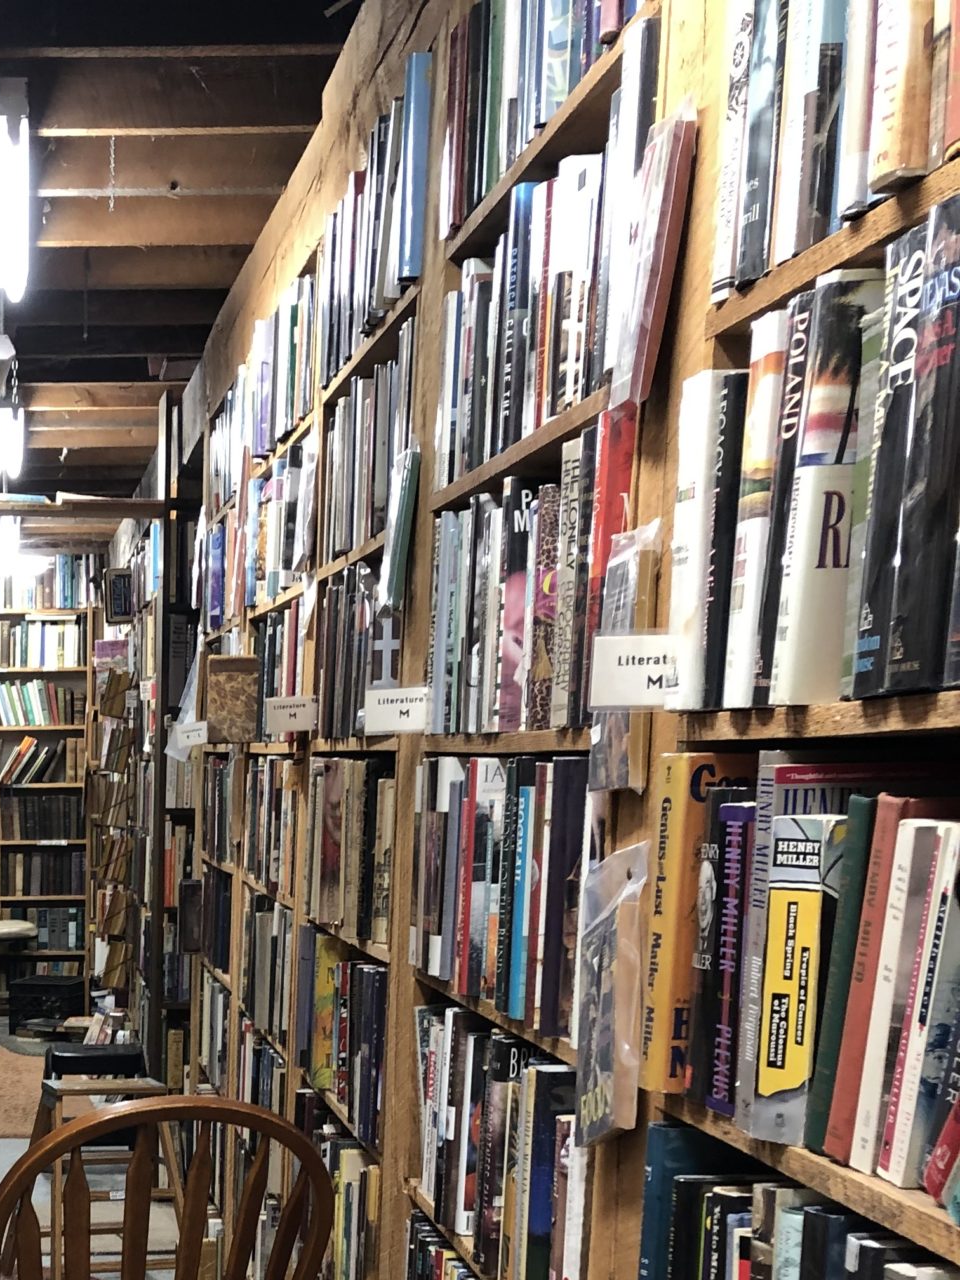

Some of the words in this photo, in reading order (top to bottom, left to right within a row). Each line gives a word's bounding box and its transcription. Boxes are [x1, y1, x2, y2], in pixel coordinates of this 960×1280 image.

[504, 318, 515, 354] CALL
[886, 250, 927, 396] SPACE
[502, 362, 512, 384] ME
[778, 310, 810, 440] POLAND
[712, 386, 729, 478] LEGACY
[565, 496, 578, 571] LONELY
[617, 654, 668, 667] Literat
[377, 696, 424, 706] Literature
[647, 674, 664, 690] M
[273, 703, 306, 711] Literature
[289, 712, 297, 720] M
[399, 709, 410, 719] M
[756, 777, 775, 835] HENRY
[656, 797, 673, 860] Genius
[778, 840, 820, 855] HENRY
[722, 820, 744, 889] HENRY
[775, 854, 819, 867] MILLER
[652, 875, 665, 917] Lust
[751, 843, 771, 909] MILLER
[718, 897, 740, 974] MILLER
[788, 903, 798, 937] Black
[646, 931, 664, 992] Mailer
[783, 939, 795, 978] Spring
[799, 950, 810, 987] Tropic
[853, 920, 872, 986] MILLER
[748, 956, 762, 1000] Robert
[799, 988, 806, 1001] of
[773, 999, 781, 1011] of
[780, 997, 790, 1019] The
[795, 1002, 807, 1044] Cancer
[642, 1005, 655, 1061] Miller
[744, 1002, 759, 1064] Ferguson
[768, 1012, 781, 1062] Maroussi
[776, 1020, 789, 1067] Colossus
[711, 1023, 734, 1102] PLEXUS
[888, 1065, 904, 1124] MILLER
[707, 1202, 722, 1243] Yukio
